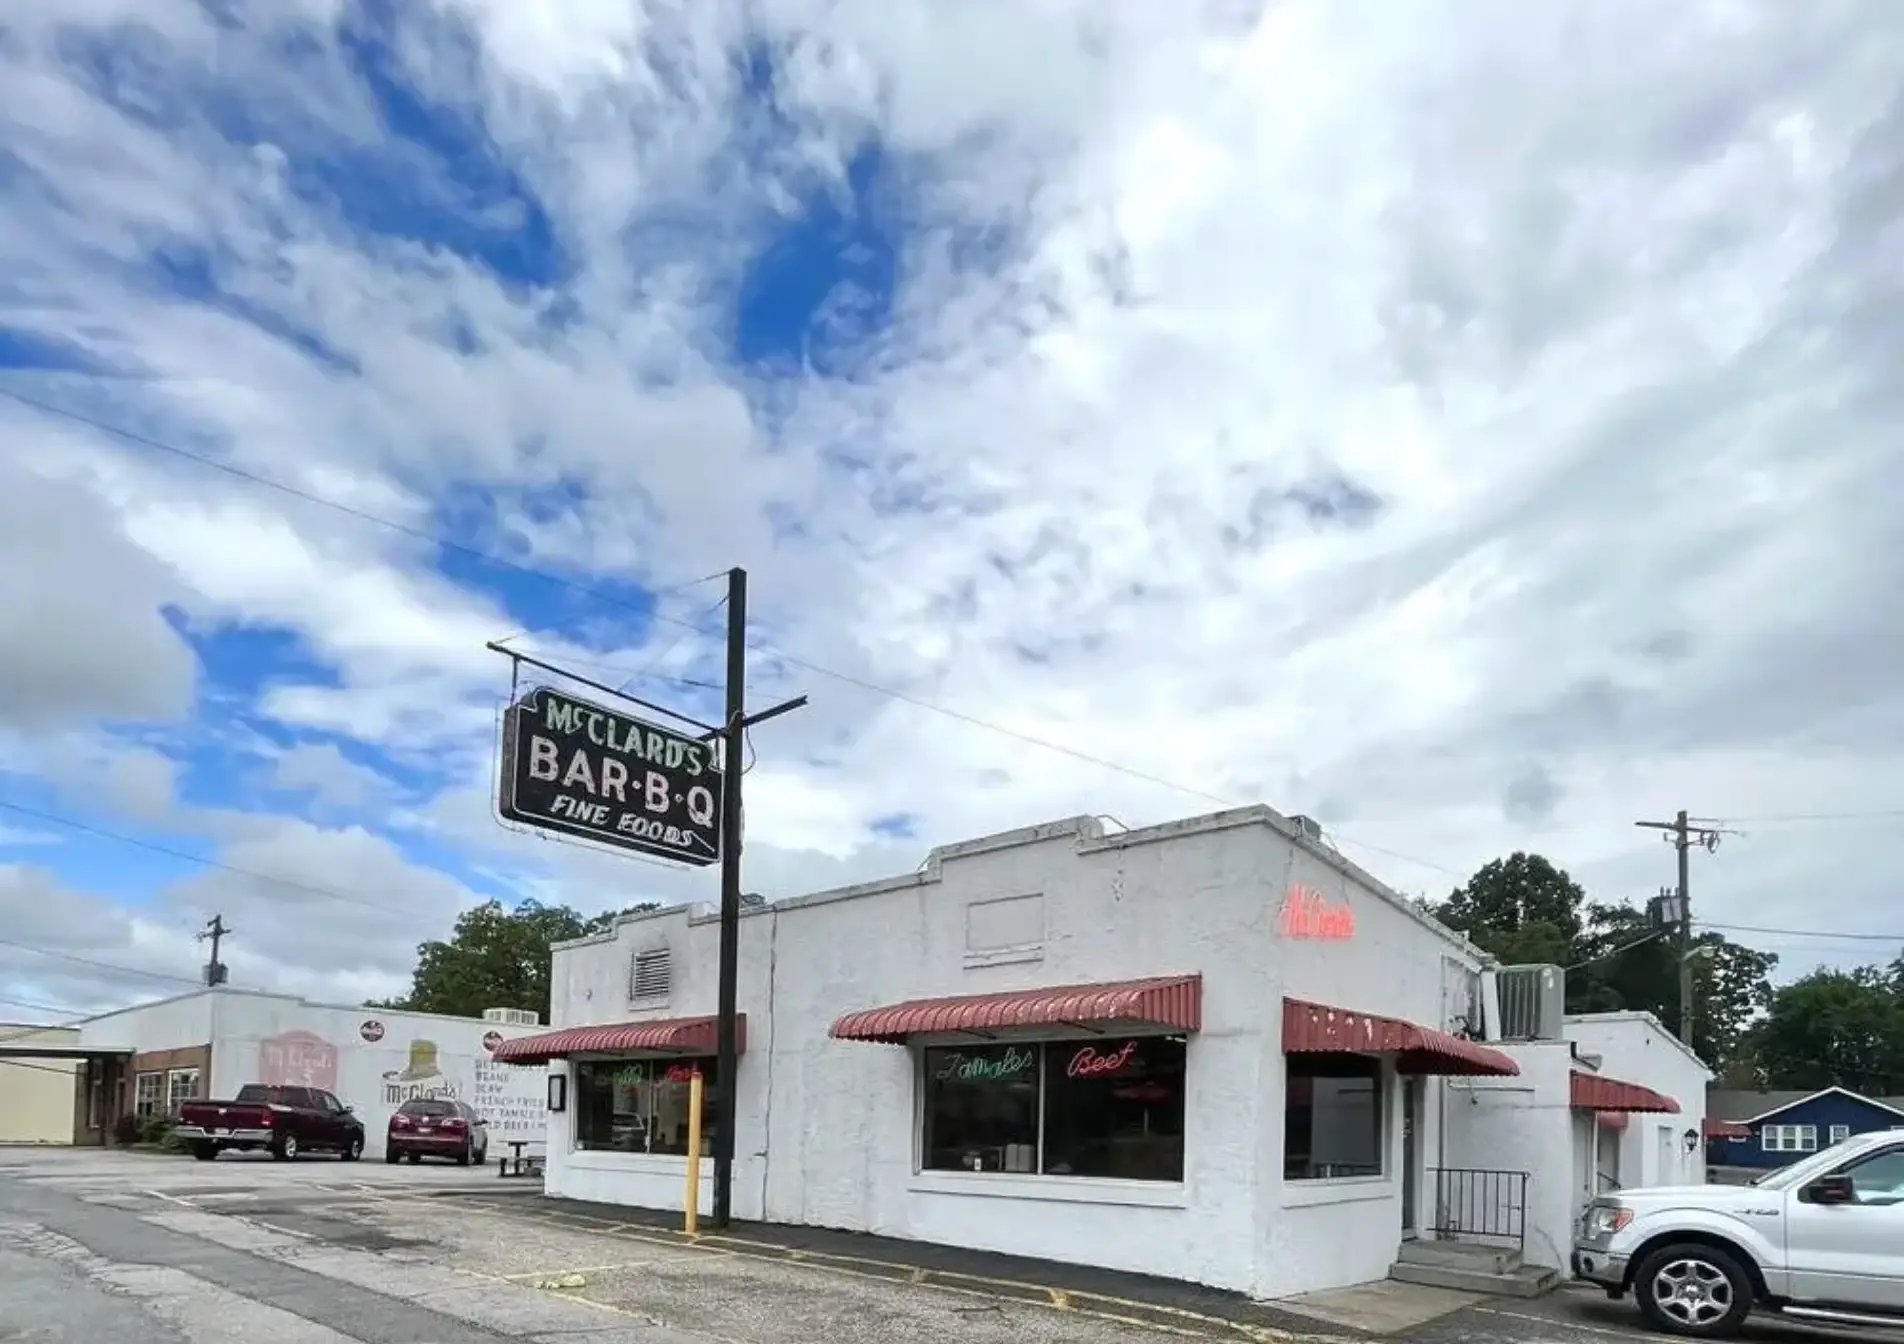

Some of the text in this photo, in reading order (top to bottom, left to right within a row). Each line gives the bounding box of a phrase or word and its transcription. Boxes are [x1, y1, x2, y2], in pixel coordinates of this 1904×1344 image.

[550, 795, 693, 846] FINE FOODS
[937, 1046, 1034, 1080] Tamales
